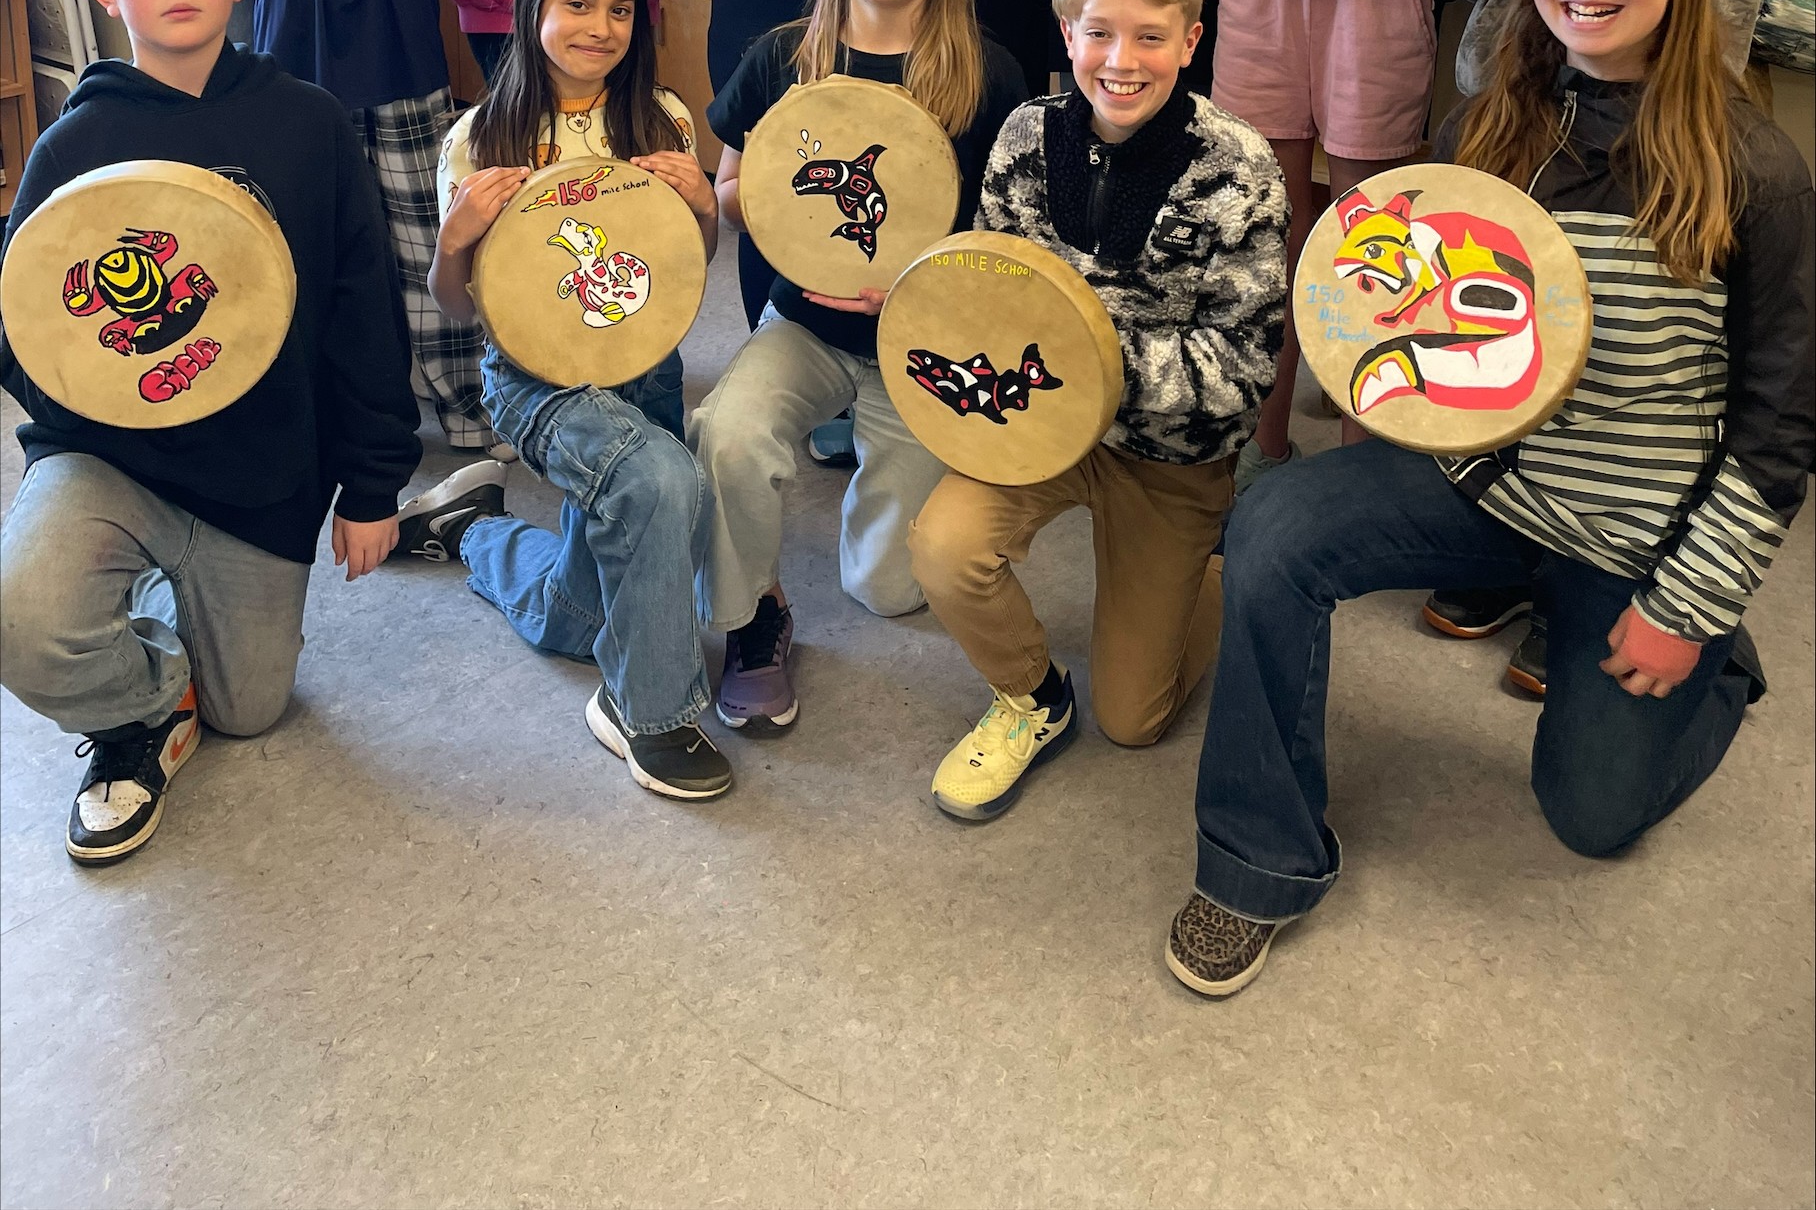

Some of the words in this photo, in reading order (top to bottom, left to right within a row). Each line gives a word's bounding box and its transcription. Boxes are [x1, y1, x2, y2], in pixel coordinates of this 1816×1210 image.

[558, 179, 598, 206] 150
[930, 254, 950, 266] 150
[955, 254, 988, 272] MILE
[1306, 284, 1345, 304] 150
